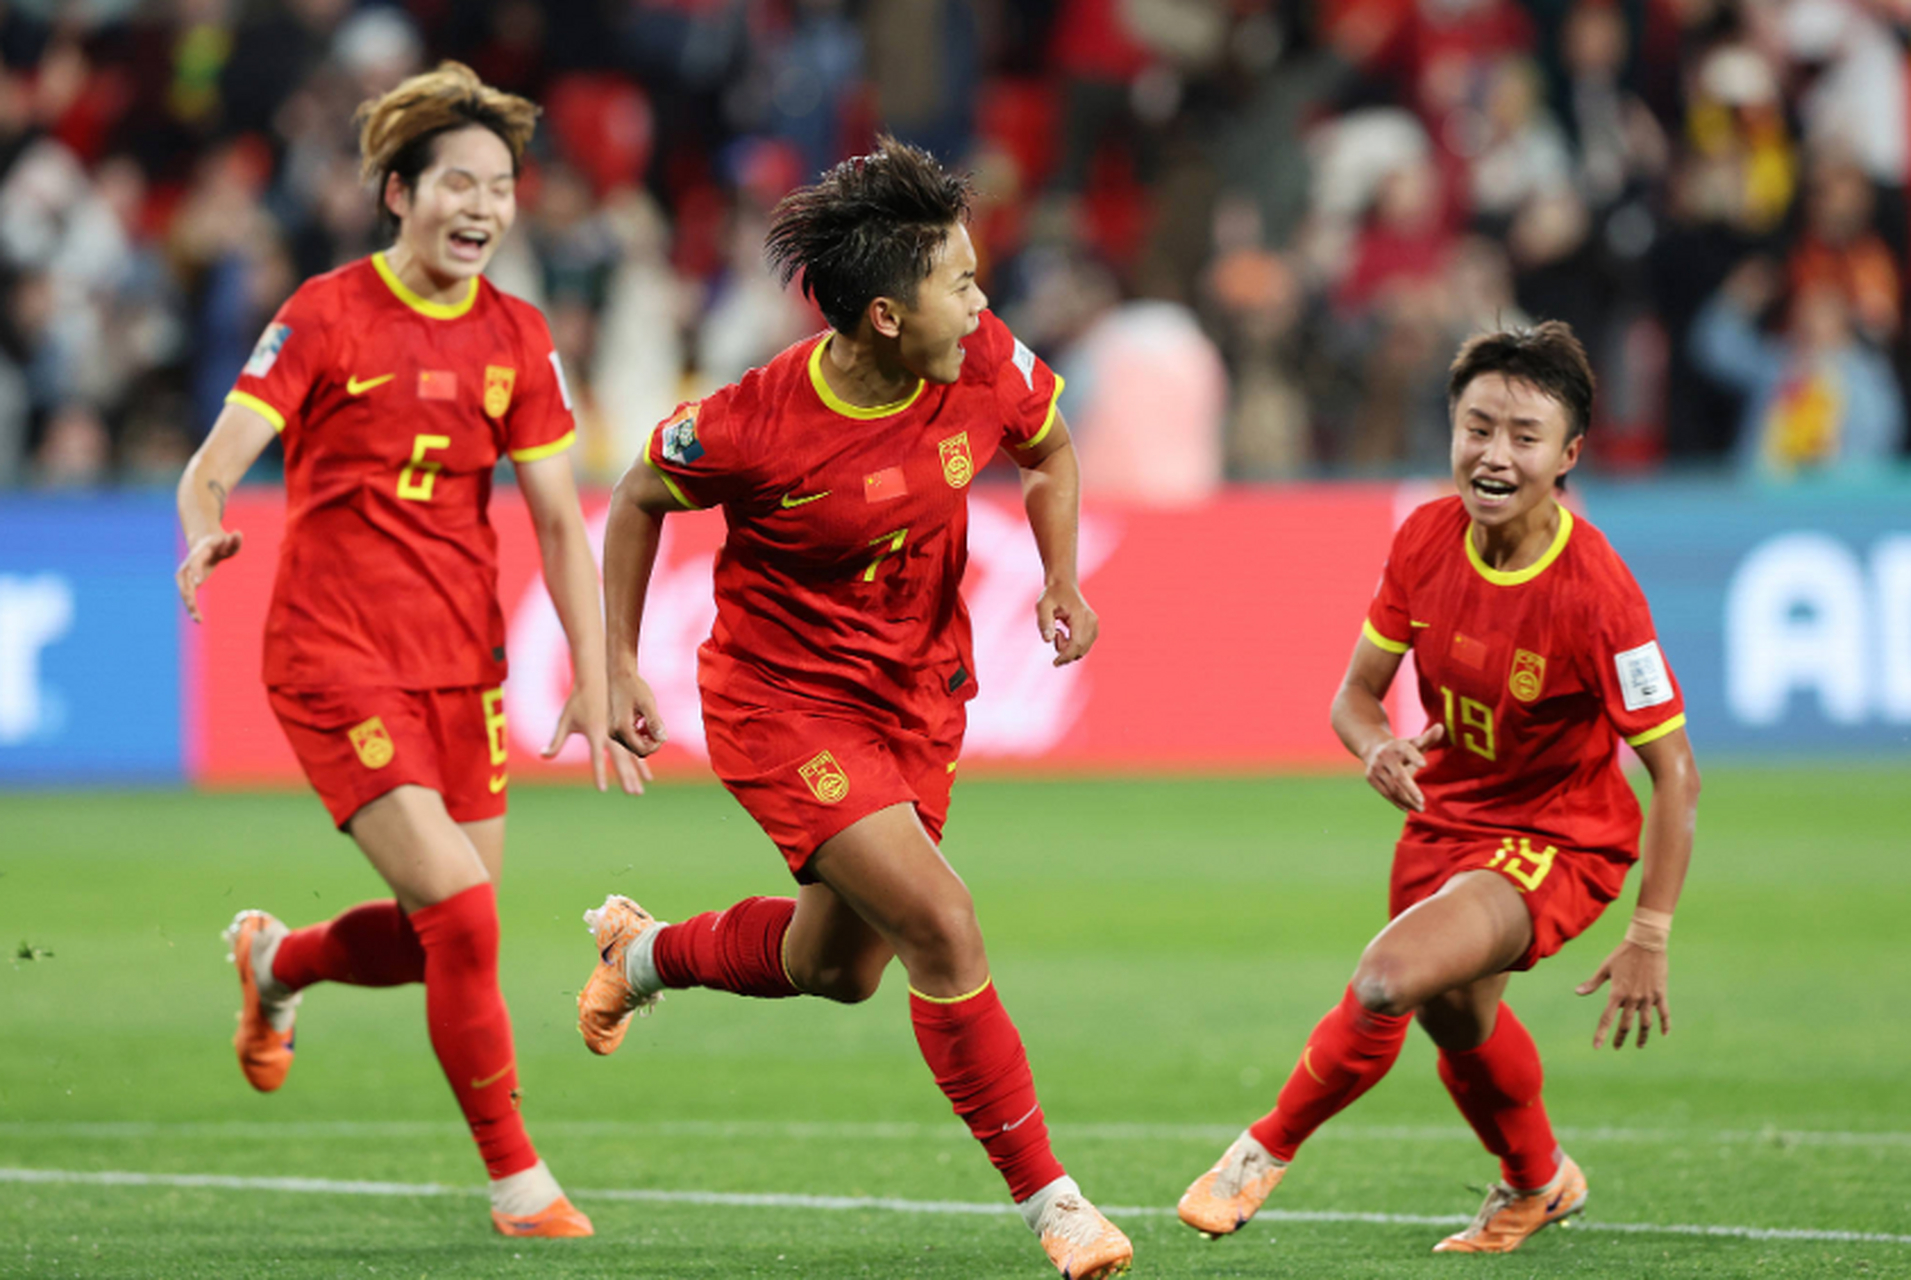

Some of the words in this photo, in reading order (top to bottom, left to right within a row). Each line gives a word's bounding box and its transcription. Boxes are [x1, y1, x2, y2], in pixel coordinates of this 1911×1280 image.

[397, 433, 450, 501] 6
[864, 528, 908, 582] 7
[1440, 686, 1496, 761] 19
